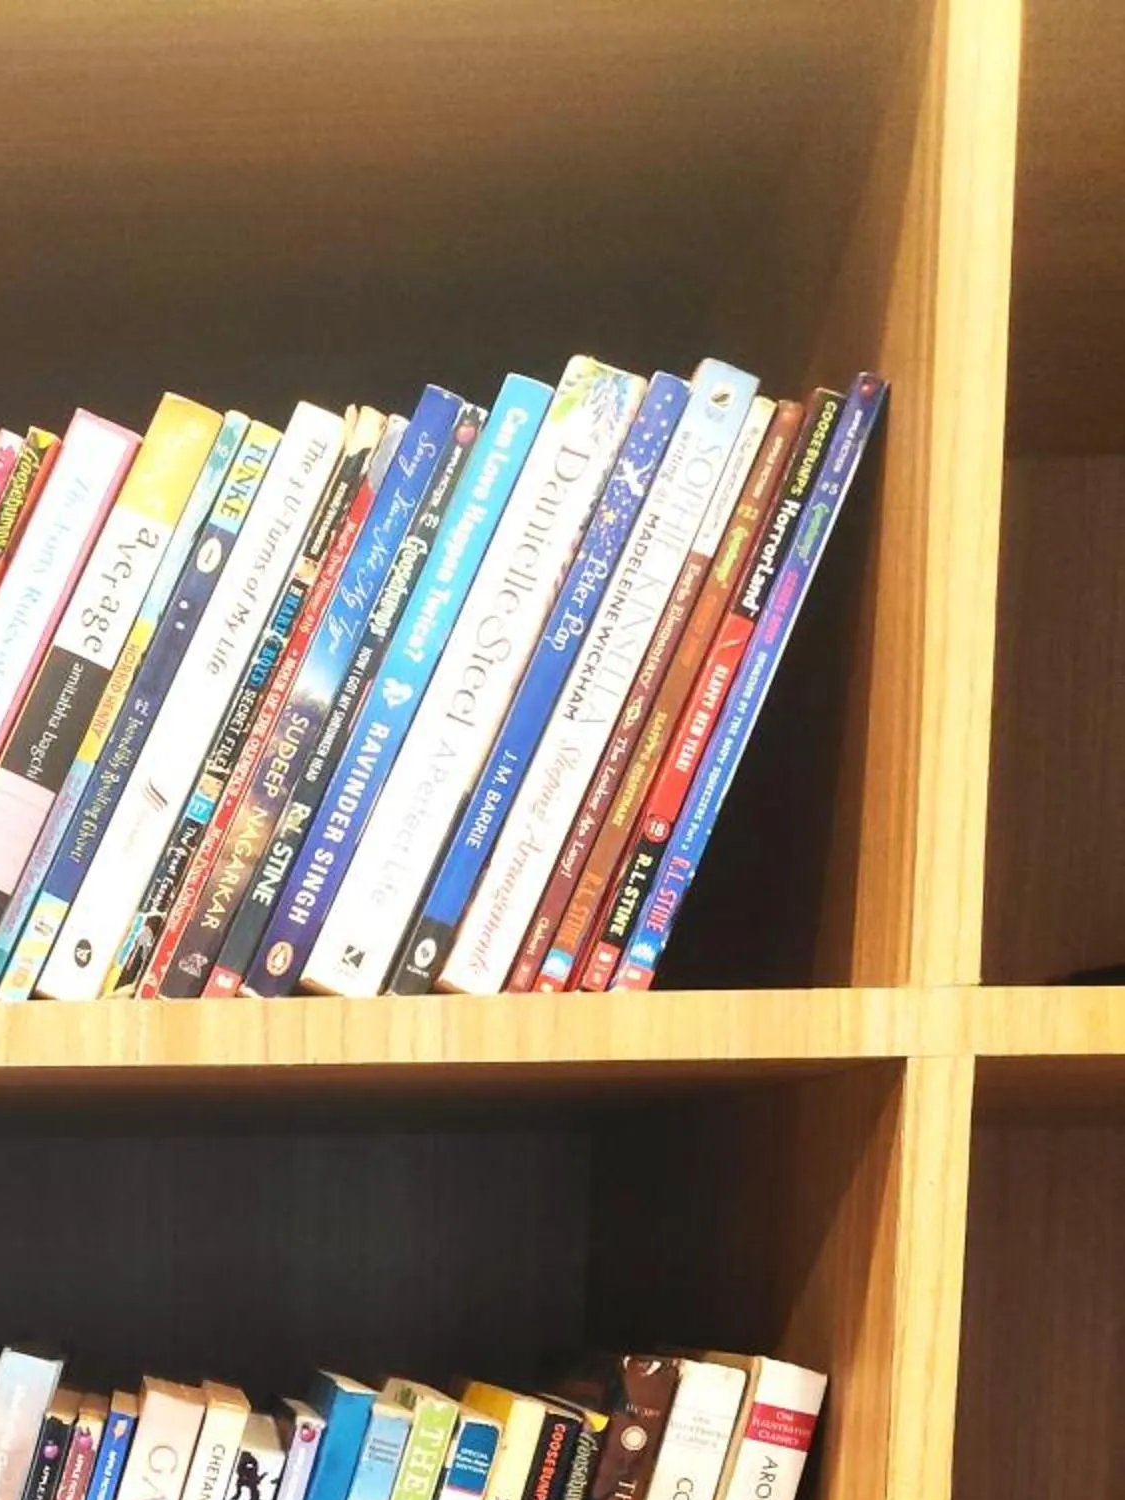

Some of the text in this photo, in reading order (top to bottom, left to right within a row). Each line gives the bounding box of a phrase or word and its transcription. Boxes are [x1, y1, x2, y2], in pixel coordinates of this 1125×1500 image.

[295, 436, 328, 479] The
[491, 403, 529, 452] Can
[787, 397, 840, 499] GOOSEBUMPS
[215, 440, 270, 522] FUNKE
[469, 447, 508, 503] Love
[250, 493, 301, 577] U-Turns
[429, 497, 486, 587] Happen
[490, 442, 591, 620] Danielle
[69, 518, 163, 661] average
[220, 600, 251, 637] My
[238, 573, 265, 602] of
[362, 531, 430, 641] Goosebumps
[399, 581, 452, 665] Twice?
[539, 550, 612, 658] Peter Pan
[46, 660, 88, 731] amitabha
[203, 635, 236, 679] Life
[439, 610, 522, 732] Steel
[18, 727, 59, 784] bagchi
[257, 711, 310, 800] SUDEEP
[284, 715, 392, 928] RAVINDER SINGH
[462, 787, 502, 851] BARRIE
[198, 802, 270, 933] NAGARKAR
[400, 1423, 445, 1497] THE
